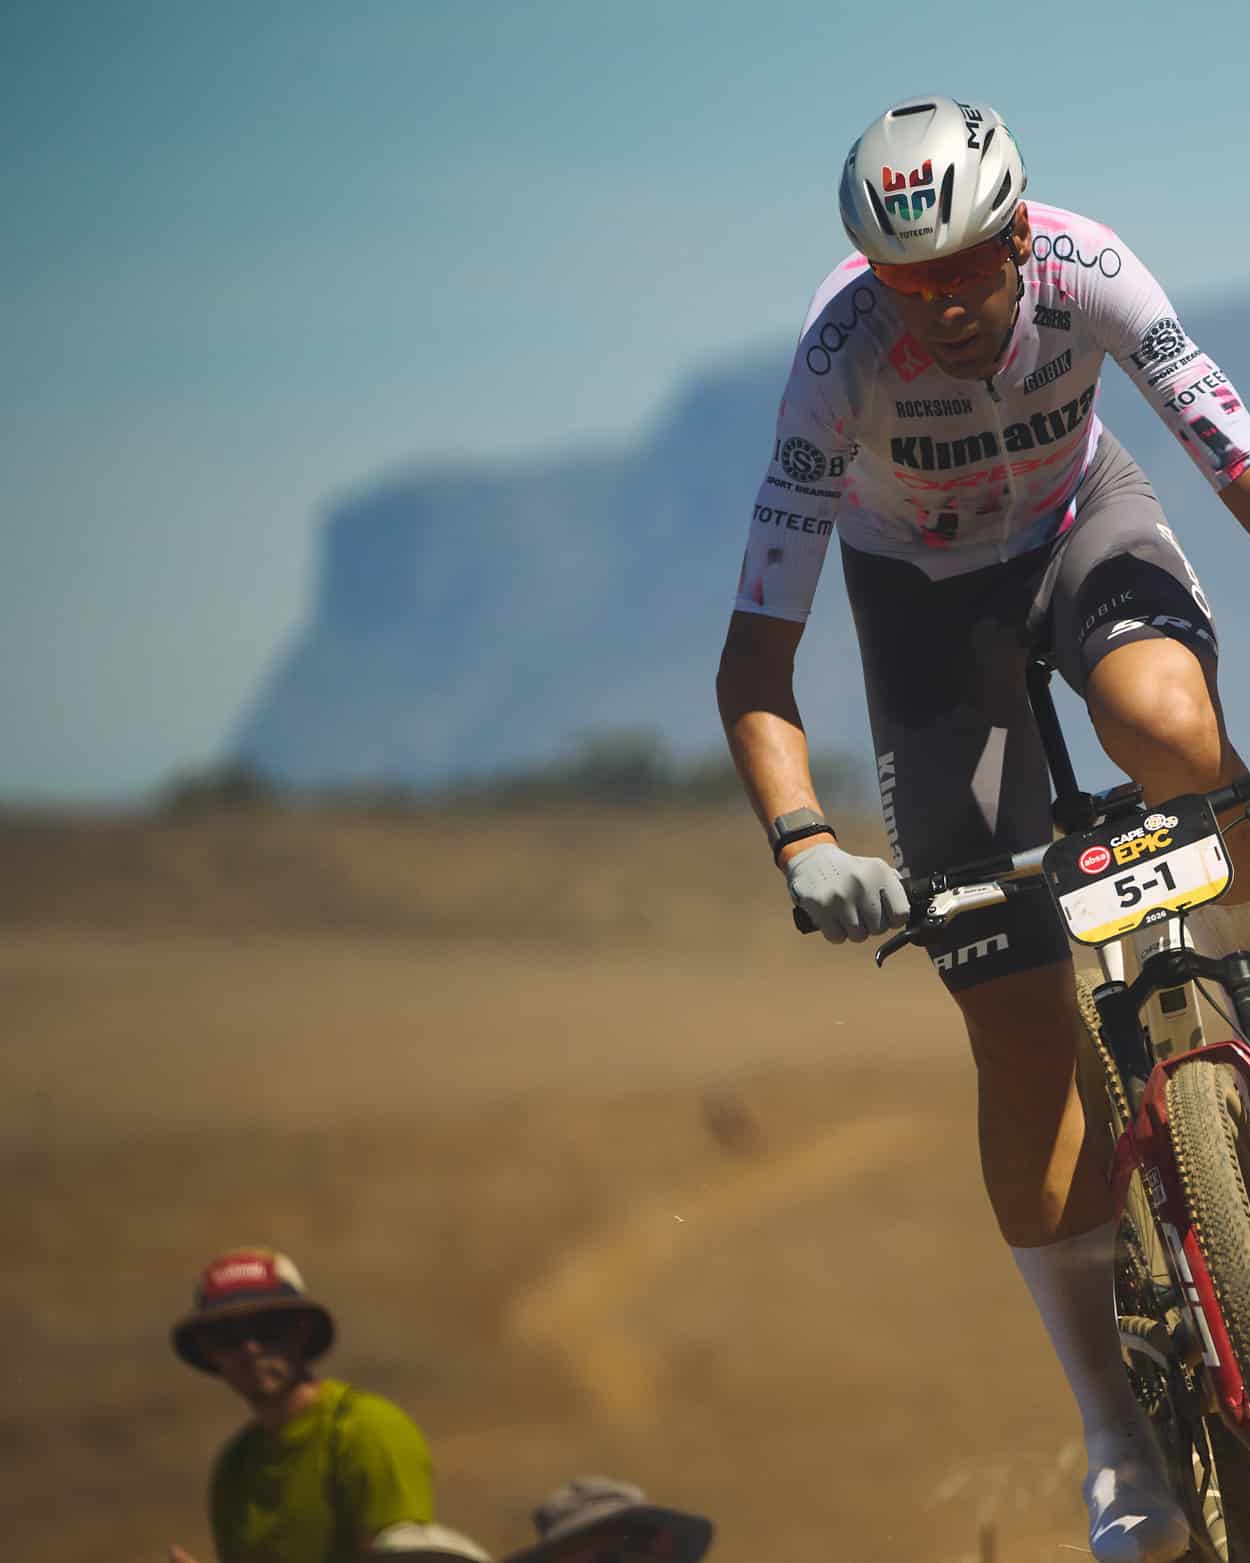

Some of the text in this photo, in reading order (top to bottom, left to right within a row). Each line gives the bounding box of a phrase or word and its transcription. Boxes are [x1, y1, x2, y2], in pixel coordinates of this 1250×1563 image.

[1110, 828, 1145, 847] CAPE
[1113, 829, 1173, 865] EPIC
[1114, 862, 1176, 908] 5-1
[1146, 910, 1167, 923] 2026
